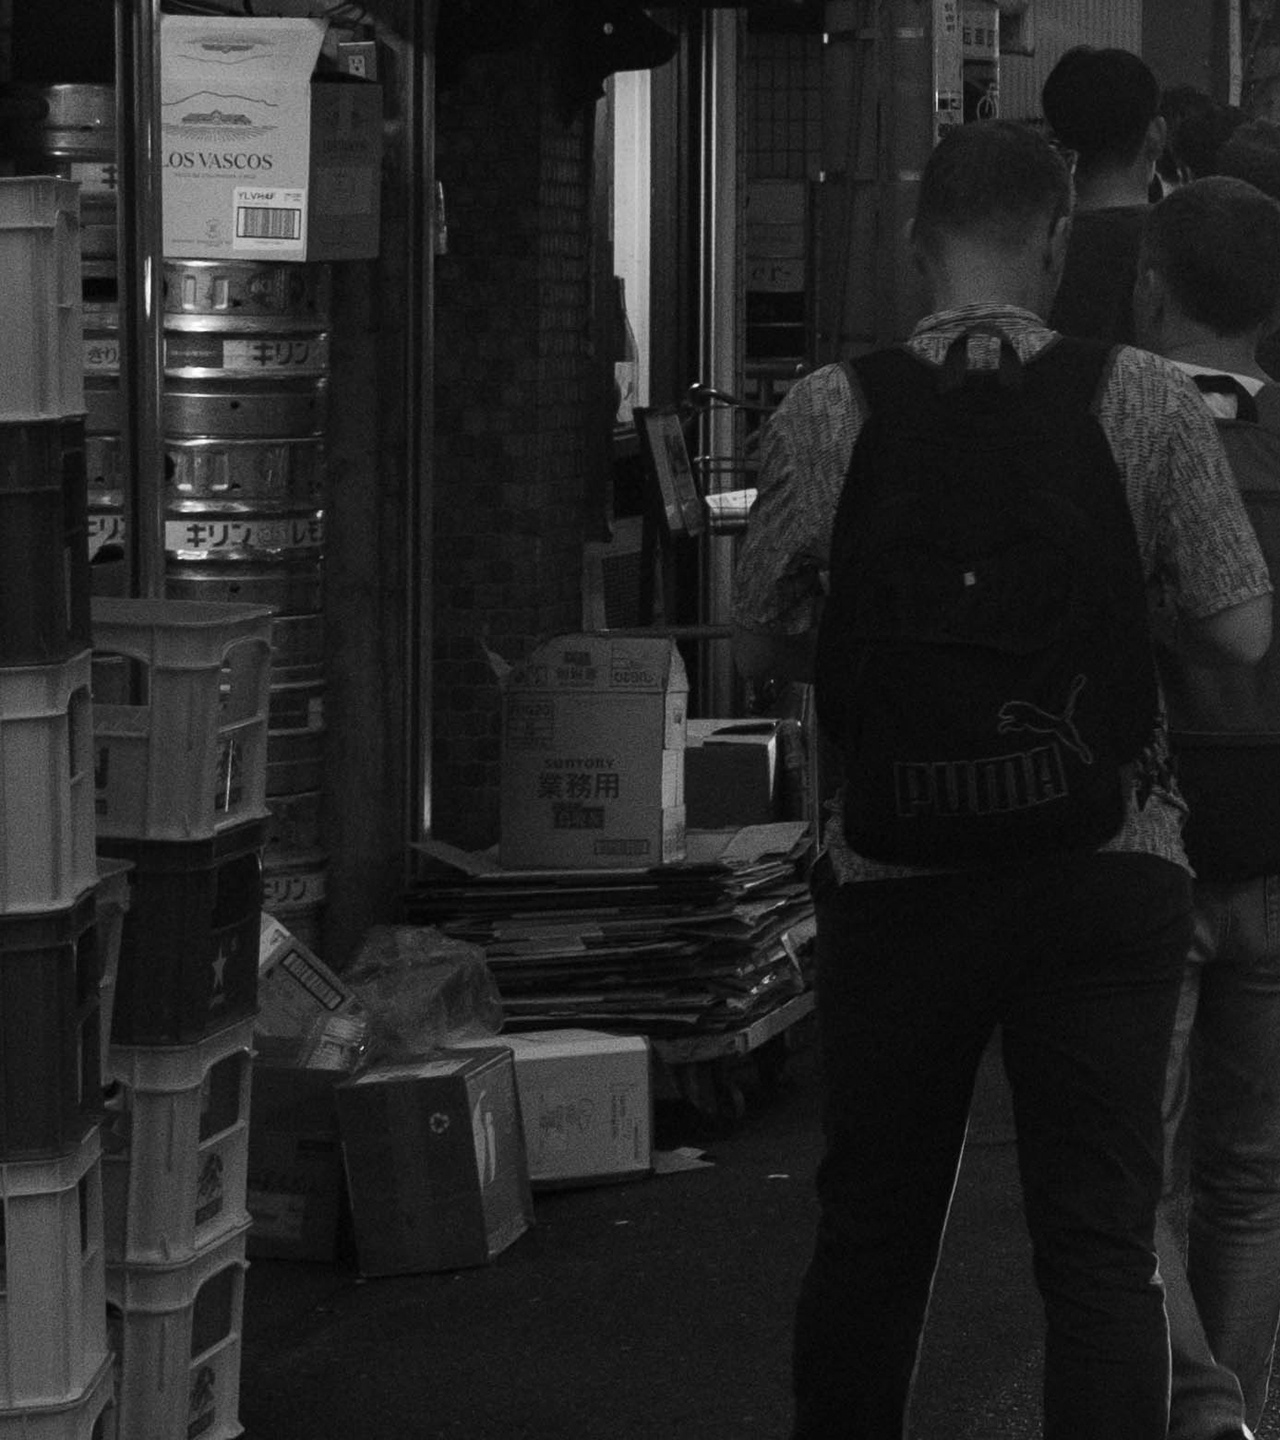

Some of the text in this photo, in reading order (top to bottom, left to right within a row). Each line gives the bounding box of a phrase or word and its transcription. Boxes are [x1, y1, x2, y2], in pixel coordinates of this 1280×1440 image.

[198, 152, 274, 171] VASCOS
[253, 342, 310, 366] キリン
[187, 524, 251, 548] キリン
[544, 758, 615, 770] SUNTORY
[538, 772, 620, 800] 業務用
[894, 742, 1069, 817] PUMA
